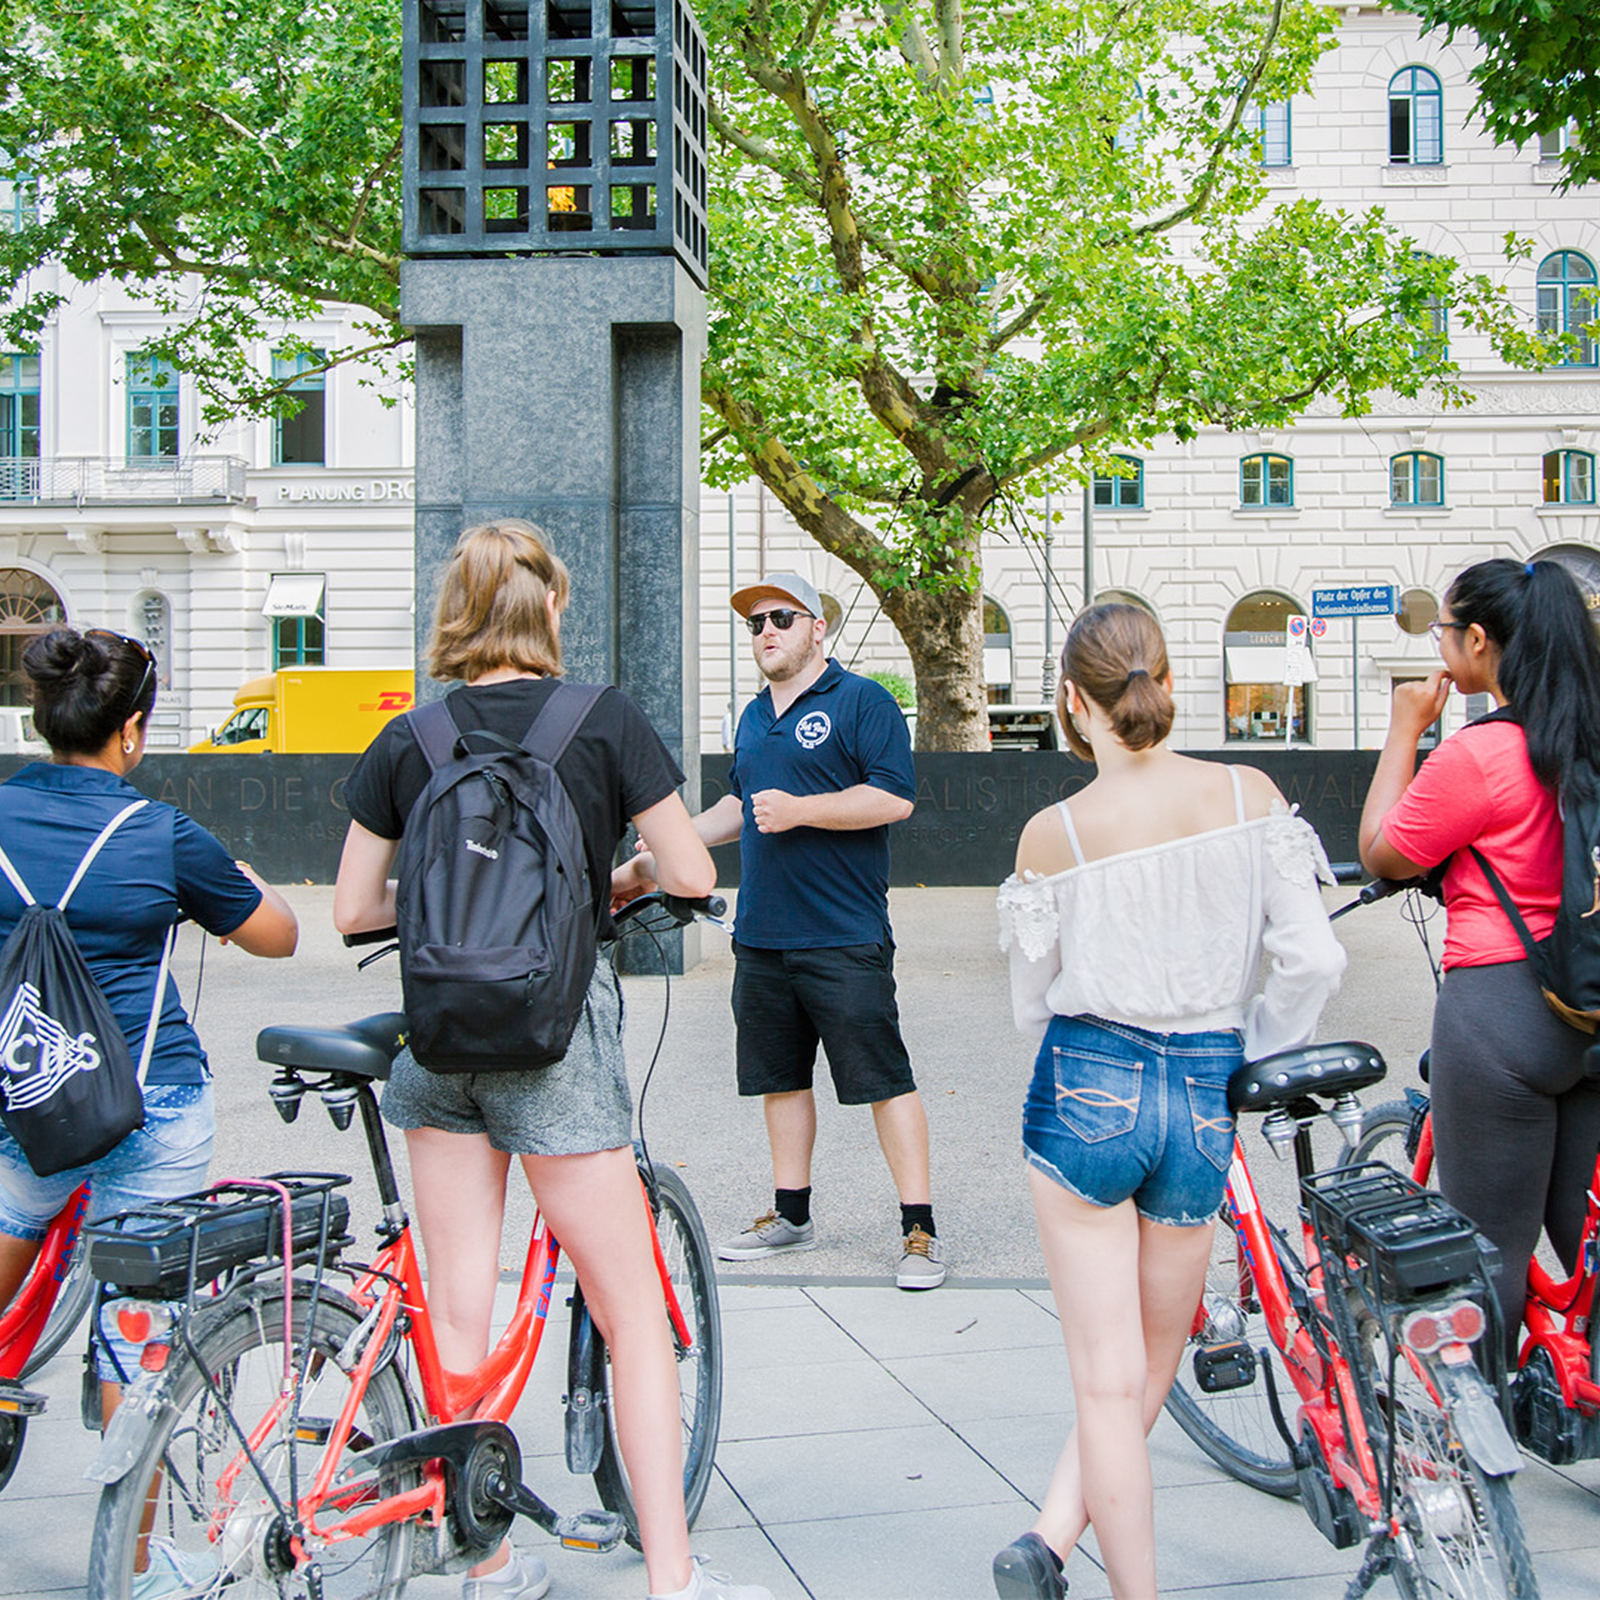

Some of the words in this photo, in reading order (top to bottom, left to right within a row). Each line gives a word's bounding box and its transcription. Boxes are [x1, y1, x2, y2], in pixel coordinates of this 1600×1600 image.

[278, 485, 365, 502] PLANUNG
[1315, 591, 1335, 603] Platz
[1336, 591, 1349, 602] der
[1350, 589, 1371, 602] Opfer
[1373, 588, 1388, 600] des
[158, 777, 212, 811] AN
[240, 777, 303, 811] DIE
